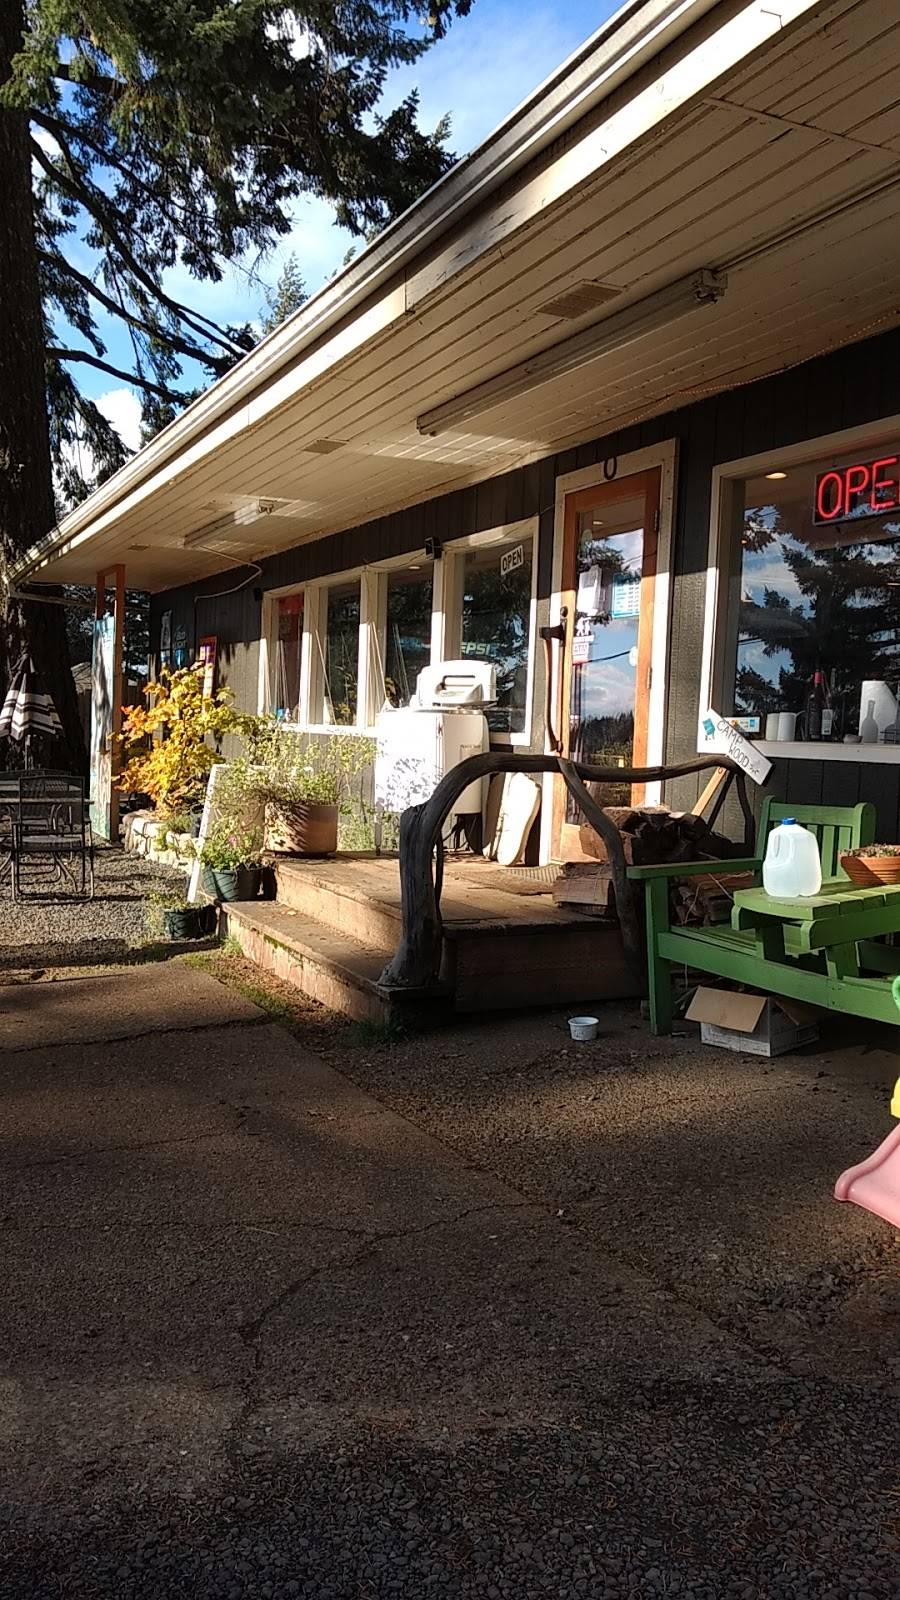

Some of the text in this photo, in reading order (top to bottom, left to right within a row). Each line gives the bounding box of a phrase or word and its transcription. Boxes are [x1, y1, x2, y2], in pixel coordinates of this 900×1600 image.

[818, 457, 900, 518] OPE
[502, 547, 522, 572] OPEN
[717, 720, 744, 745] CAMP
[728, 743, 750, 768] WOOD
